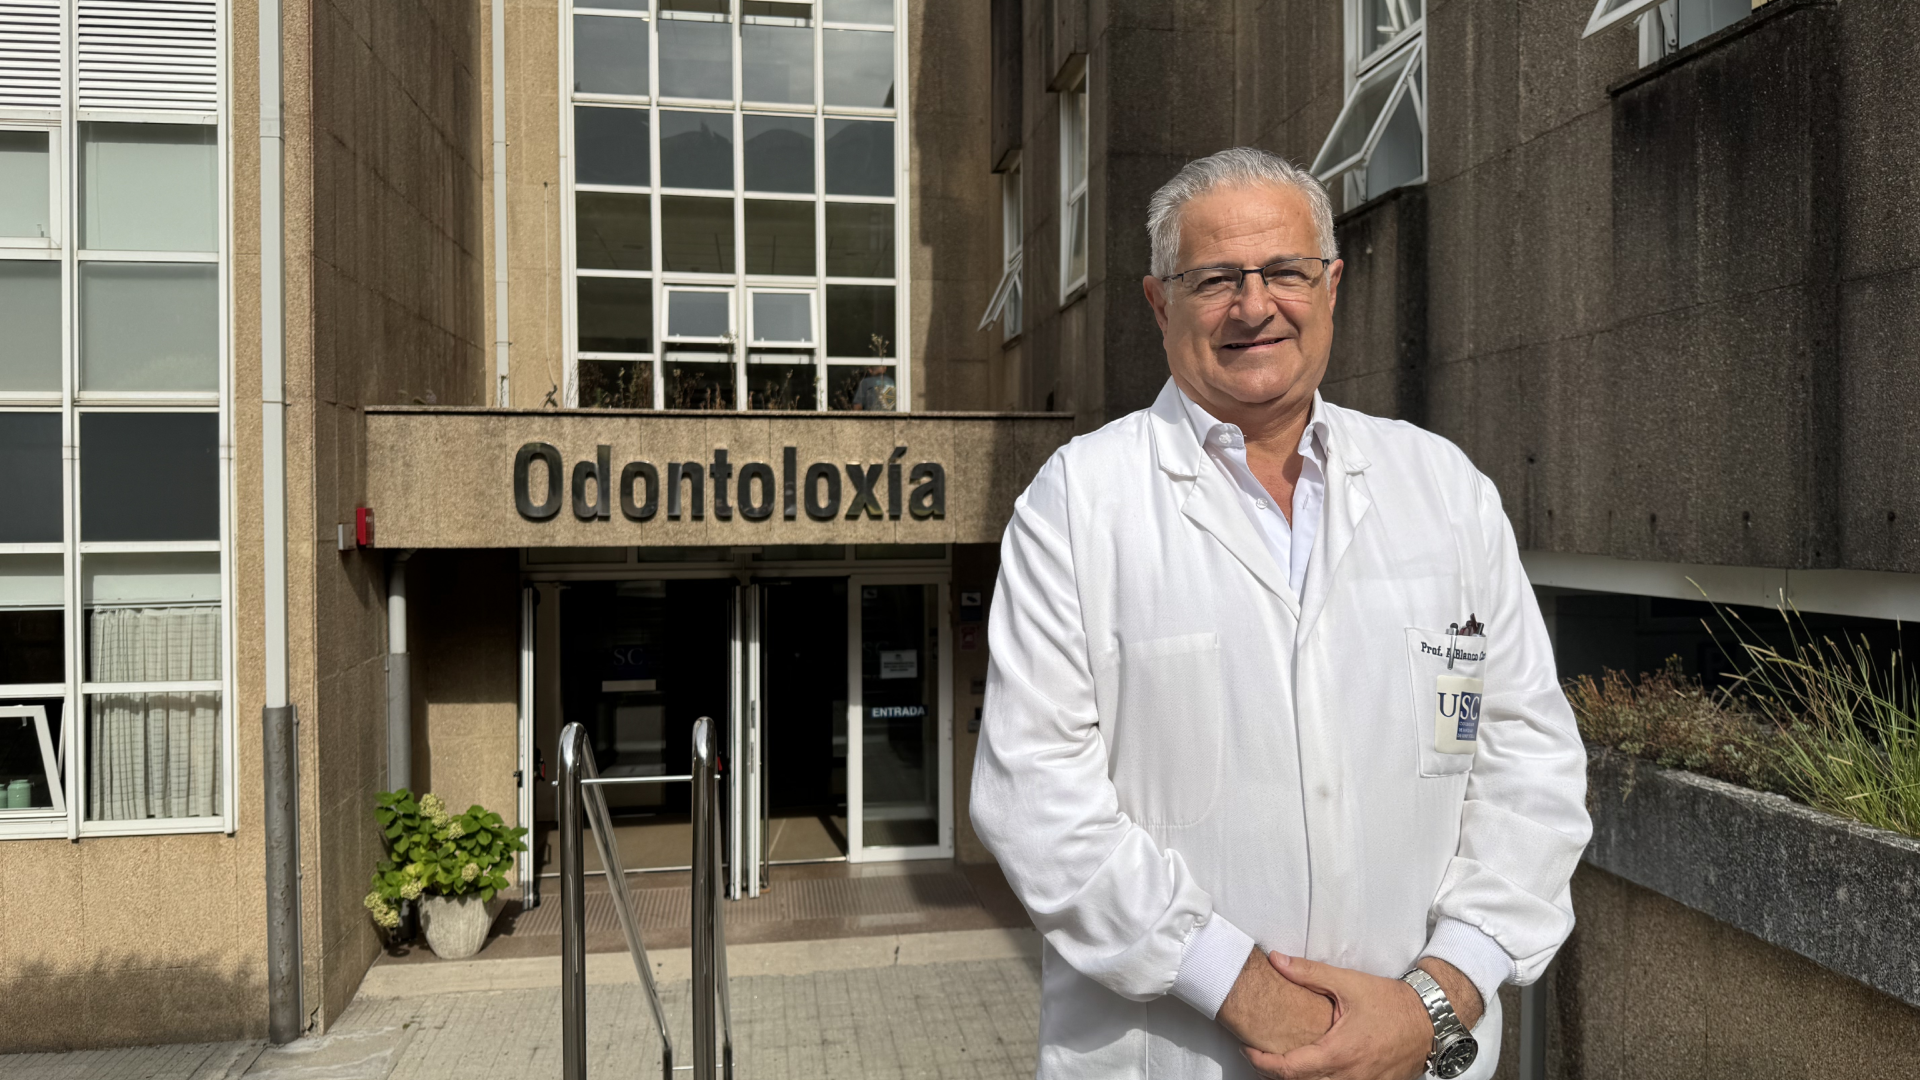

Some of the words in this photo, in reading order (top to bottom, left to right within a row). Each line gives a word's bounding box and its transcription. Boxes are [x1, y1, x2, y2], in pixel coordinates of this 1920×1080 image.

[513, 442, 947, 522] Odontoloxía
[1421, 641, 1444, 657] Prof.
[1455, 649, 1479, 661] Blanco
[872, 706, 925, 718] ENTRADA
[1437, 692, 1480, 720] USC
